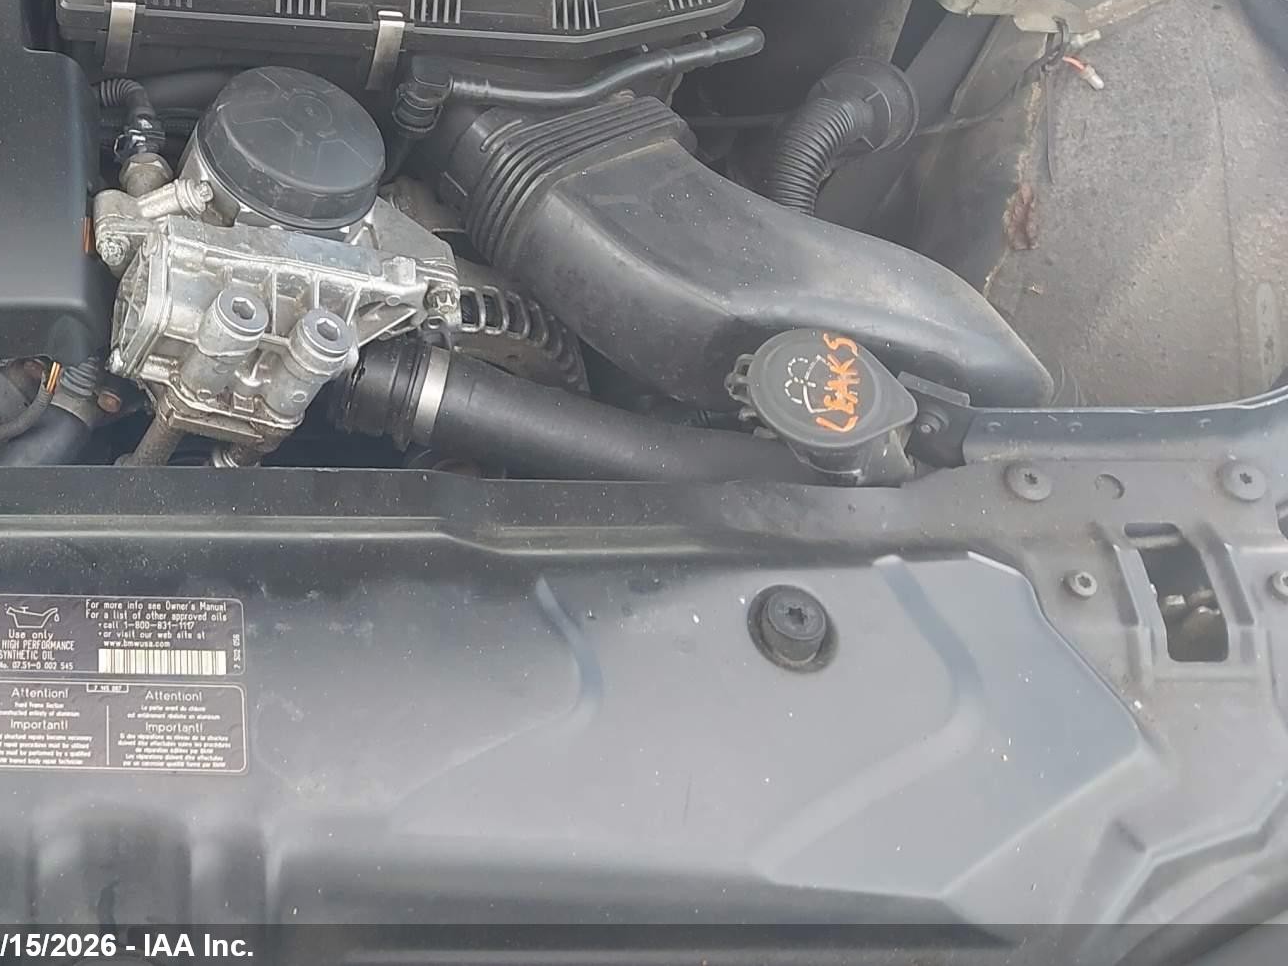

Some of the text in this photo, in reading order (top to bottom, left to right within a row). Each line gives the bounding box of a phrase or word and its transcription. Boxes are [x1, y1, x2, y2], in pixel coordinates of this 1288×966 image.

[85, 599, 99, 609] For
[103, 602, 122, 610] more
[127, 600, 143, 610] info
[165, 600, 195, 611] Owner's
[199, 601, 226, 612] Manual
[85, 609, 99, 619] For
[113, 610, 127, 620] list
[132, 610, 141, 620] of
[145, 610, 166, 620] other
[171, 612, 207, 623] approved
[211, 612, 227, 622] oils
[103, 620, 195, 630] call 1-800-831-1117
[8, 629, 54, 641] Use only
[115, 630, 135, 639] visit
[157, 630, 172, 639] web
[176, 631, 192, 639] site
[196, 630, 205, 639] at
[1, 640, 20, 650] HIGH
[22, 640, 75, 651] PERFORMANCE
[103, 640, 171, 648] www.bmwusa.com
[41, 650, 55, 660] OIL
[10, 687, 69, 699] Attention!
[144, 690, 203, 702] Attention!
[10, 719, 69, 731] Important!
[145, 722, 204, 733] Important!
